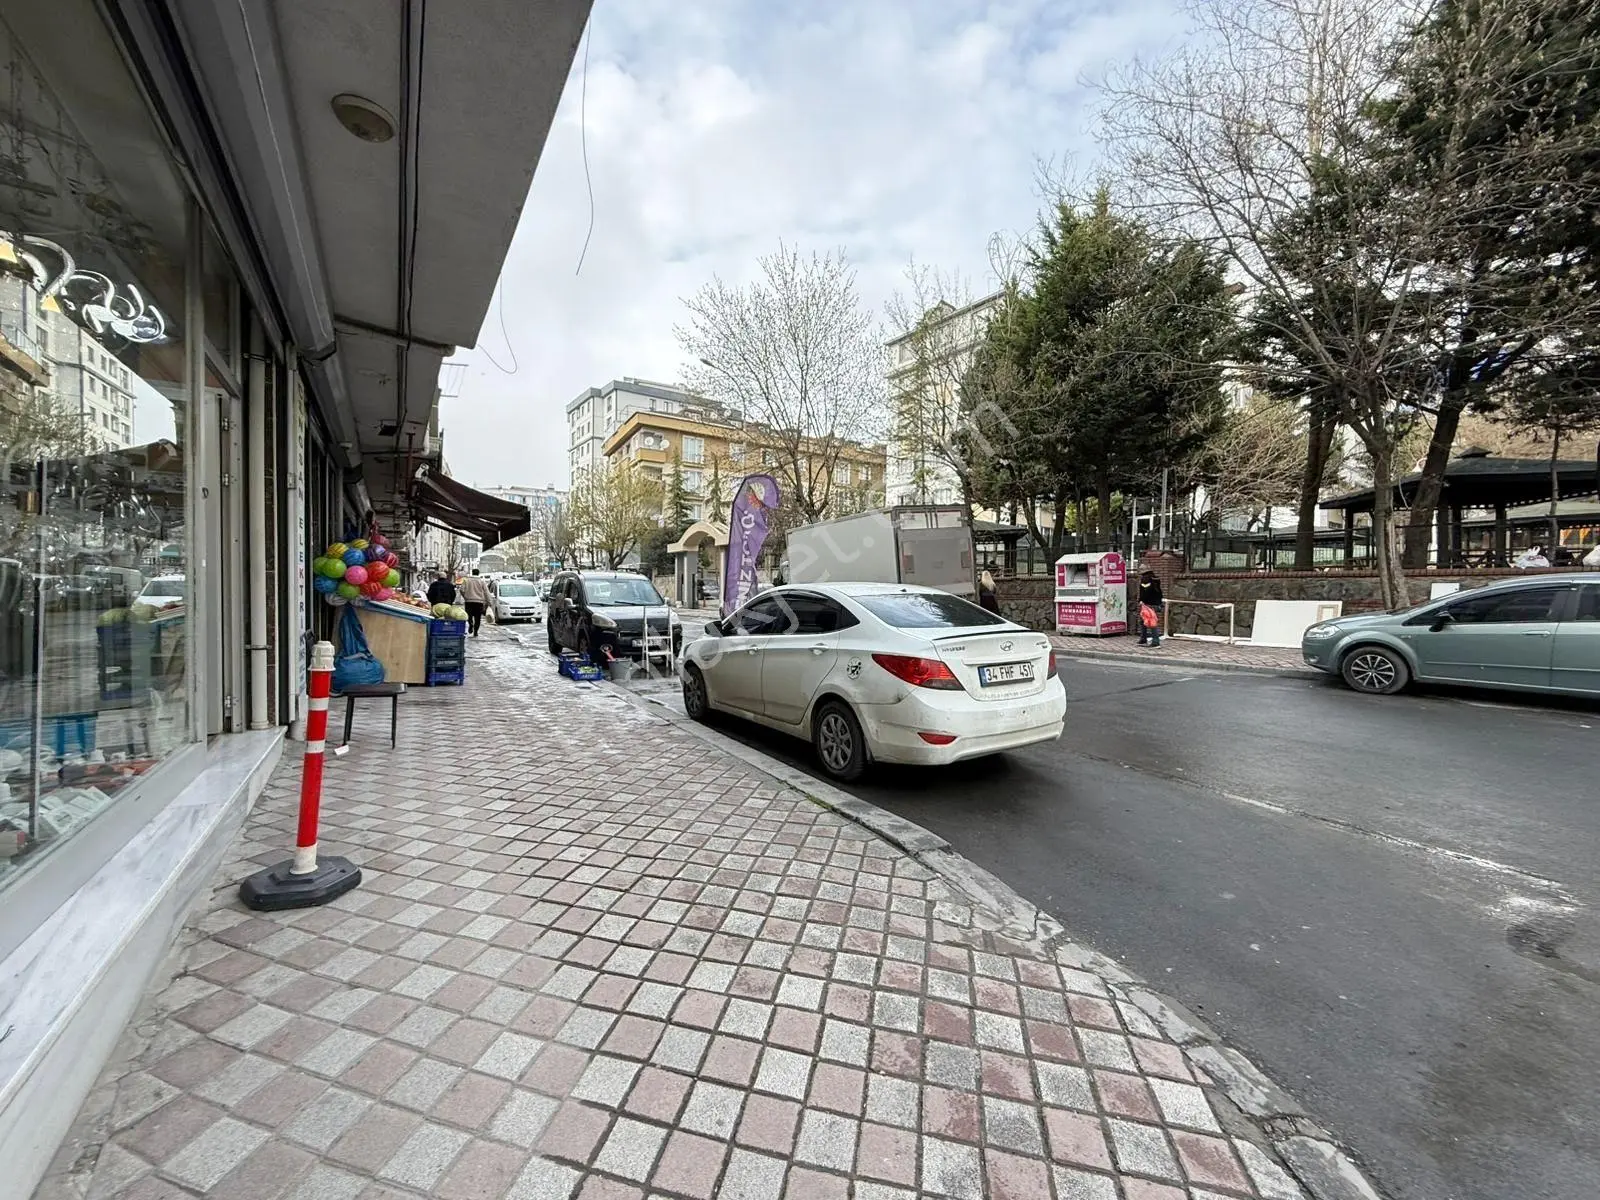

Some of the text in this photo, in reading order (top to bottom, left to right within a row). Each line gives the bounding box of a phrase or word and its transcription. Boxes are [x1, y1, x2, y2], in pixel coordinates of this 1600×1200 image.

[986, 663, 1031, 681] 34 FHF 451
